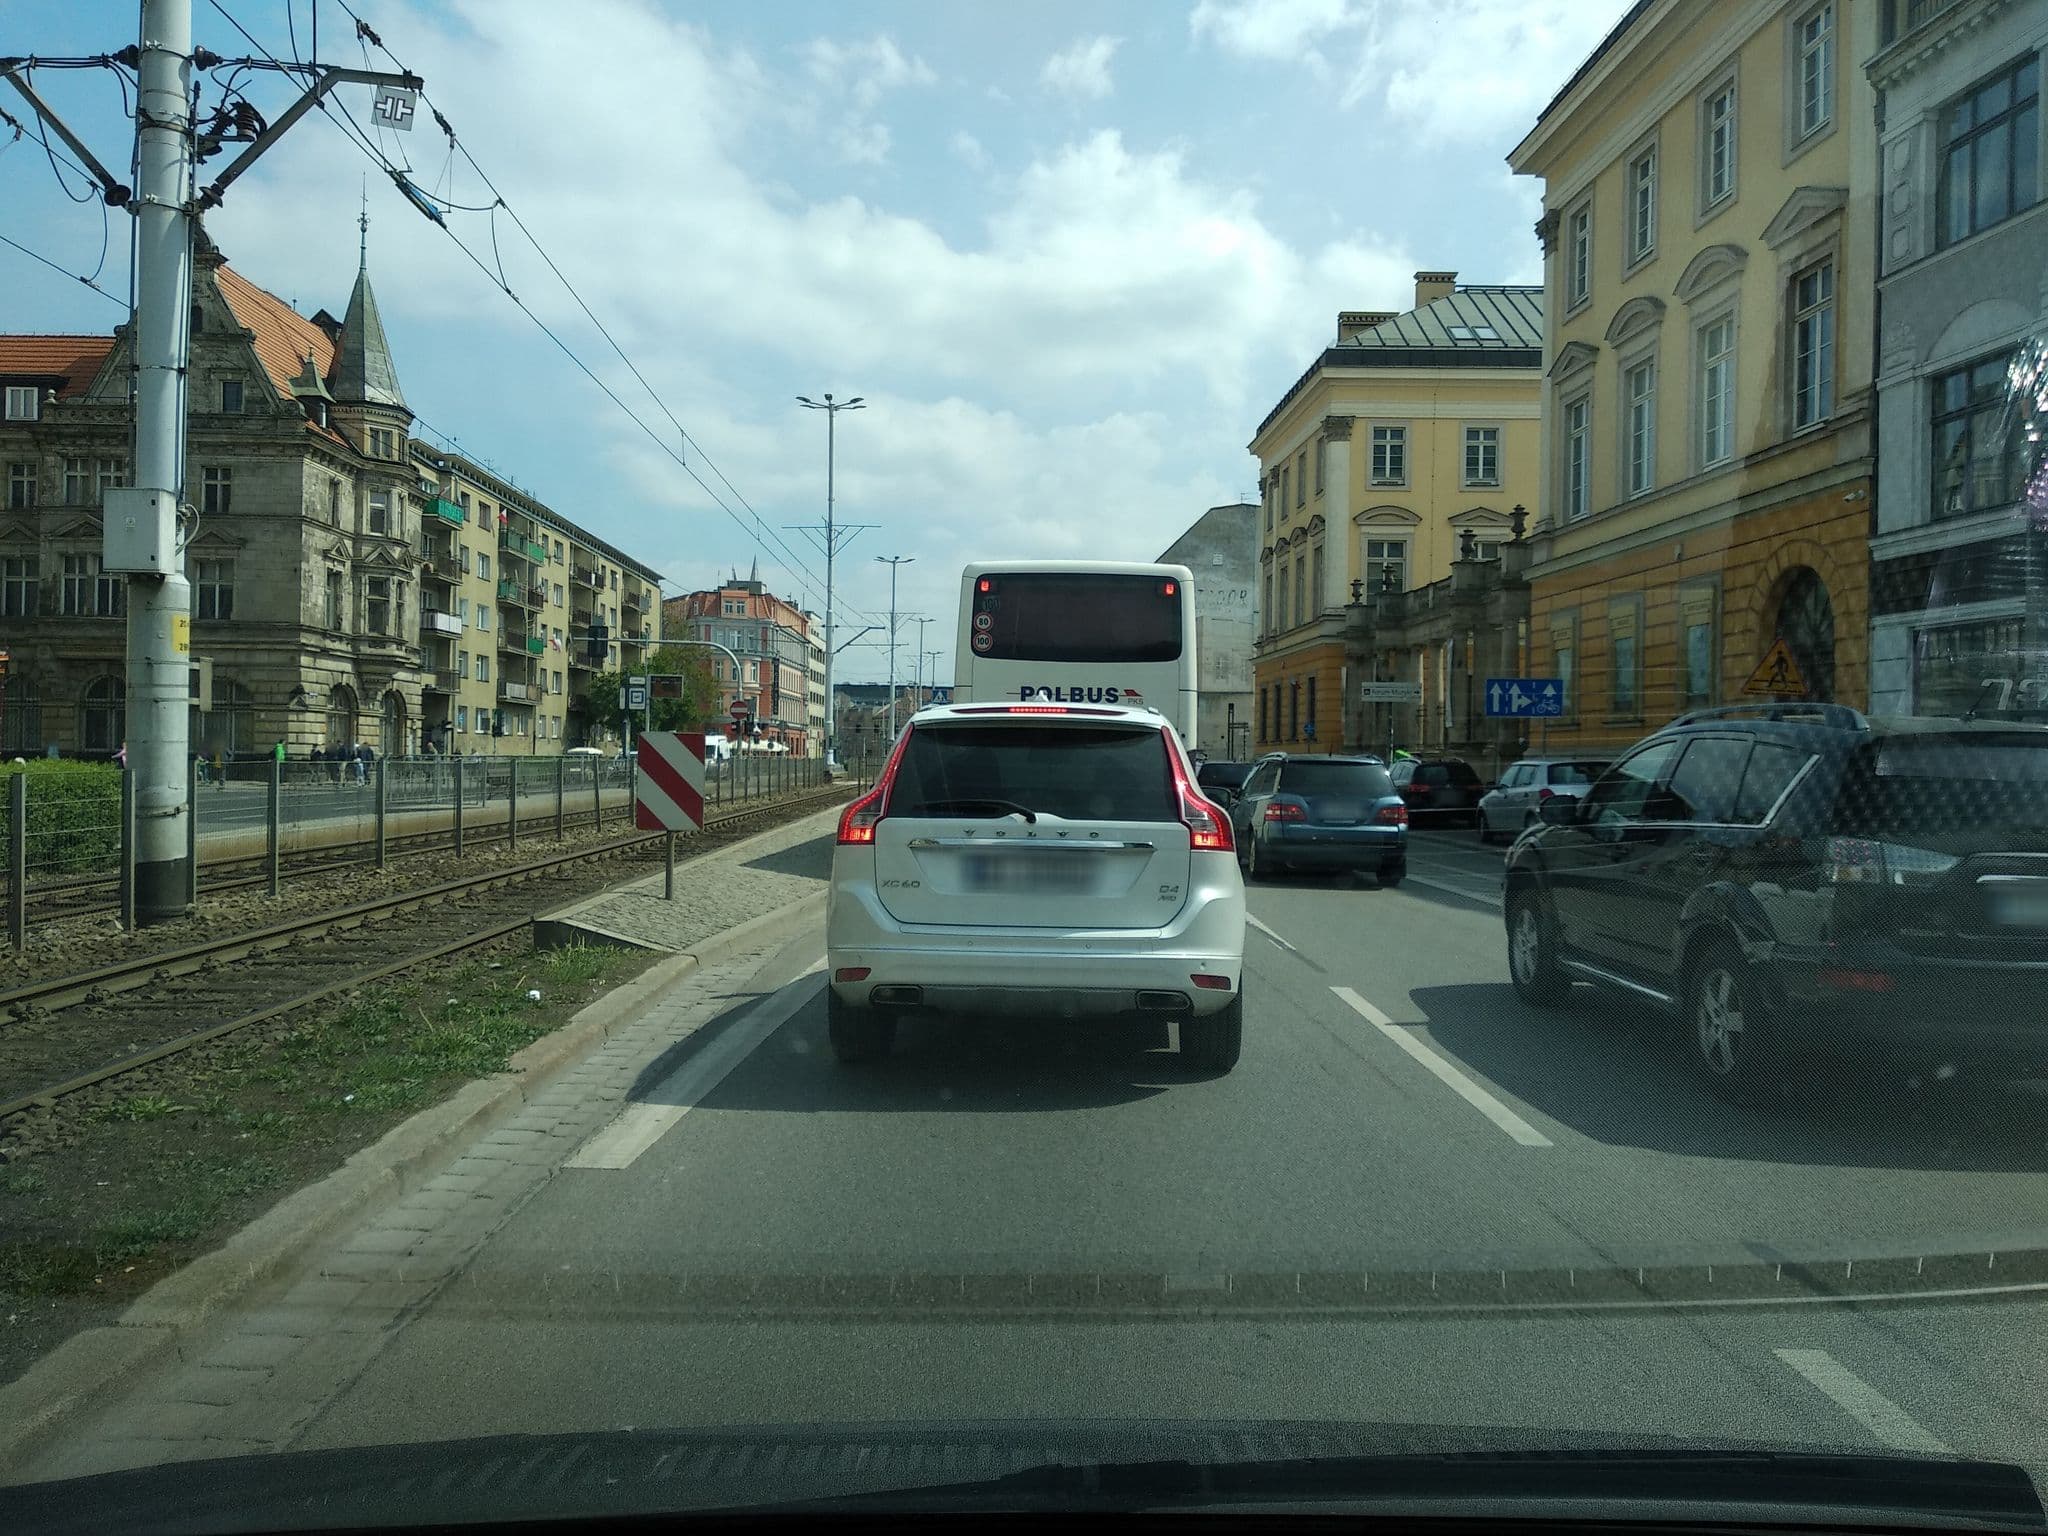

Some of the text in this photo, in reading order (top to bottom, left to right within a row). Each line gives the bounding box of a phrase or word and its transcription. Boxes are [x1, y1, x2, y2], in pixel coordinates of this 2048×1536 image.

[978, 617, 989, 626] 80
[976, 637, 990, 646] 100
[1020, 685, 1119, 704] POLBUS
[1128, 697, 1144, 705] PKS
[963, 829, 1100, 839] VOLVO
[881, 879, 920, 888] XC60
[1159, 885, 1179, 893] D4
